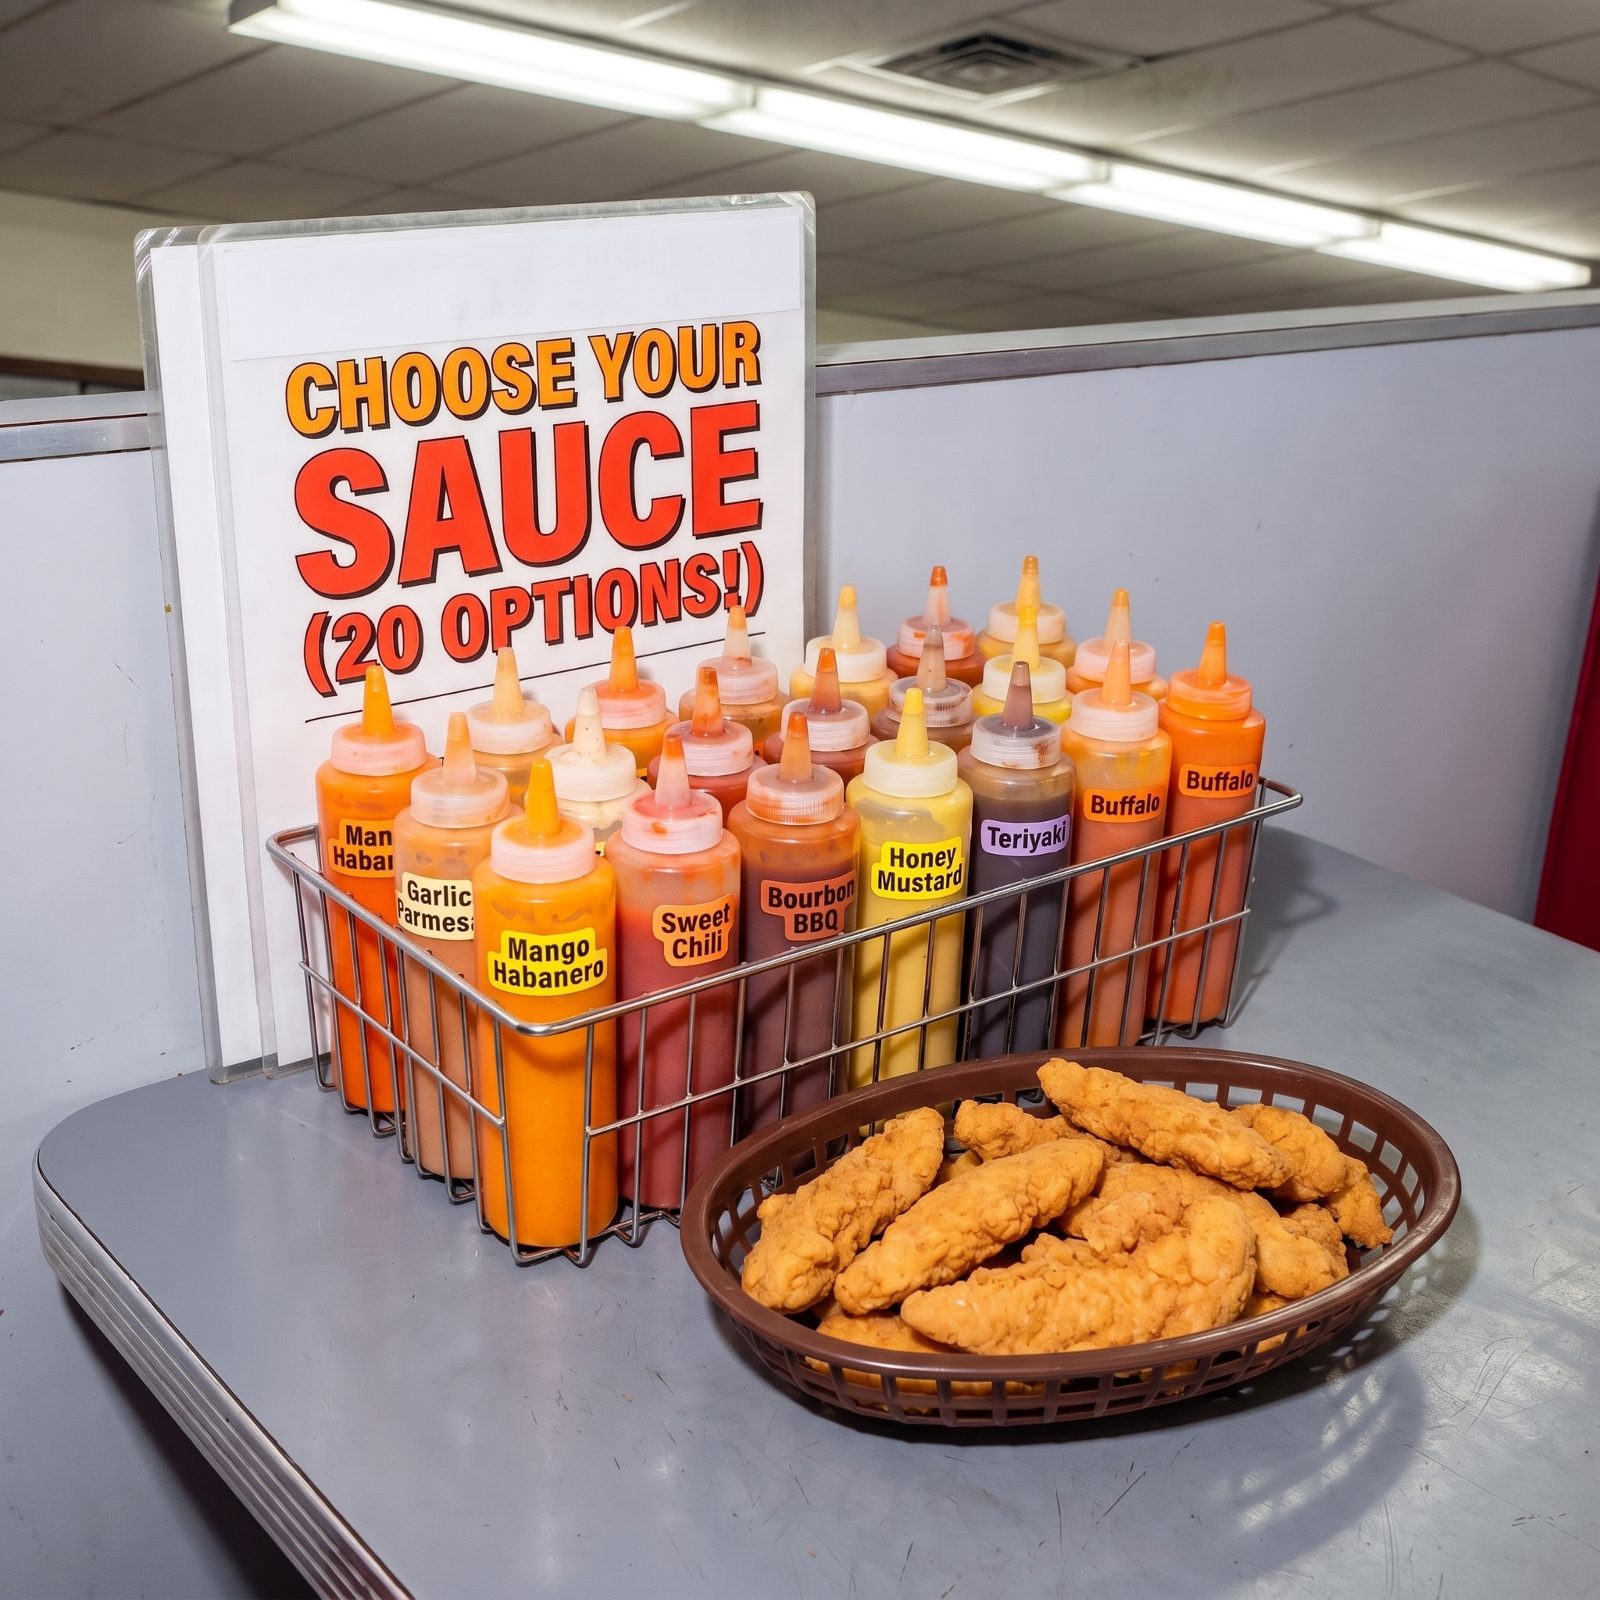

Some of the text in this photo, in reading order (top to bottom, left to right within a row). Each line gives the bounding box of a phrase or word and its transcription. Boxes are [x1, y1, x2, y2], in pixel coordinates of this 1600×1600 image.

[285, 320, 762, 439] CHOOSE YOUR
[294, 400, 764, 600] SAUCE
[303, 541, 765, 698] (20 OPTIONS!)
[1186, 769, 1254, 791] Buffalo
[1090, 794, 1160, 816] Buffalo
[345, 824, 393, 847] Man
[987, 820, 1067, 853] Teriyaki
[333, 845, 394, 871] Haba
[889, 847, 957, 870] Honey
[407, 879, 472, 907] Garlic
[877, 863, 963, 893] Mustard
[768, 878, 855, 909] Bourbon
[397, 897, 474, 933] Parmes
[661, 902, 730, 934] Sweet
[793, 908, 839, 934] BBQ
[508, 936, 590, 965] Mango
[672, 929, 722, 960] Chili
[494, 959, 604, 989] Habanero
